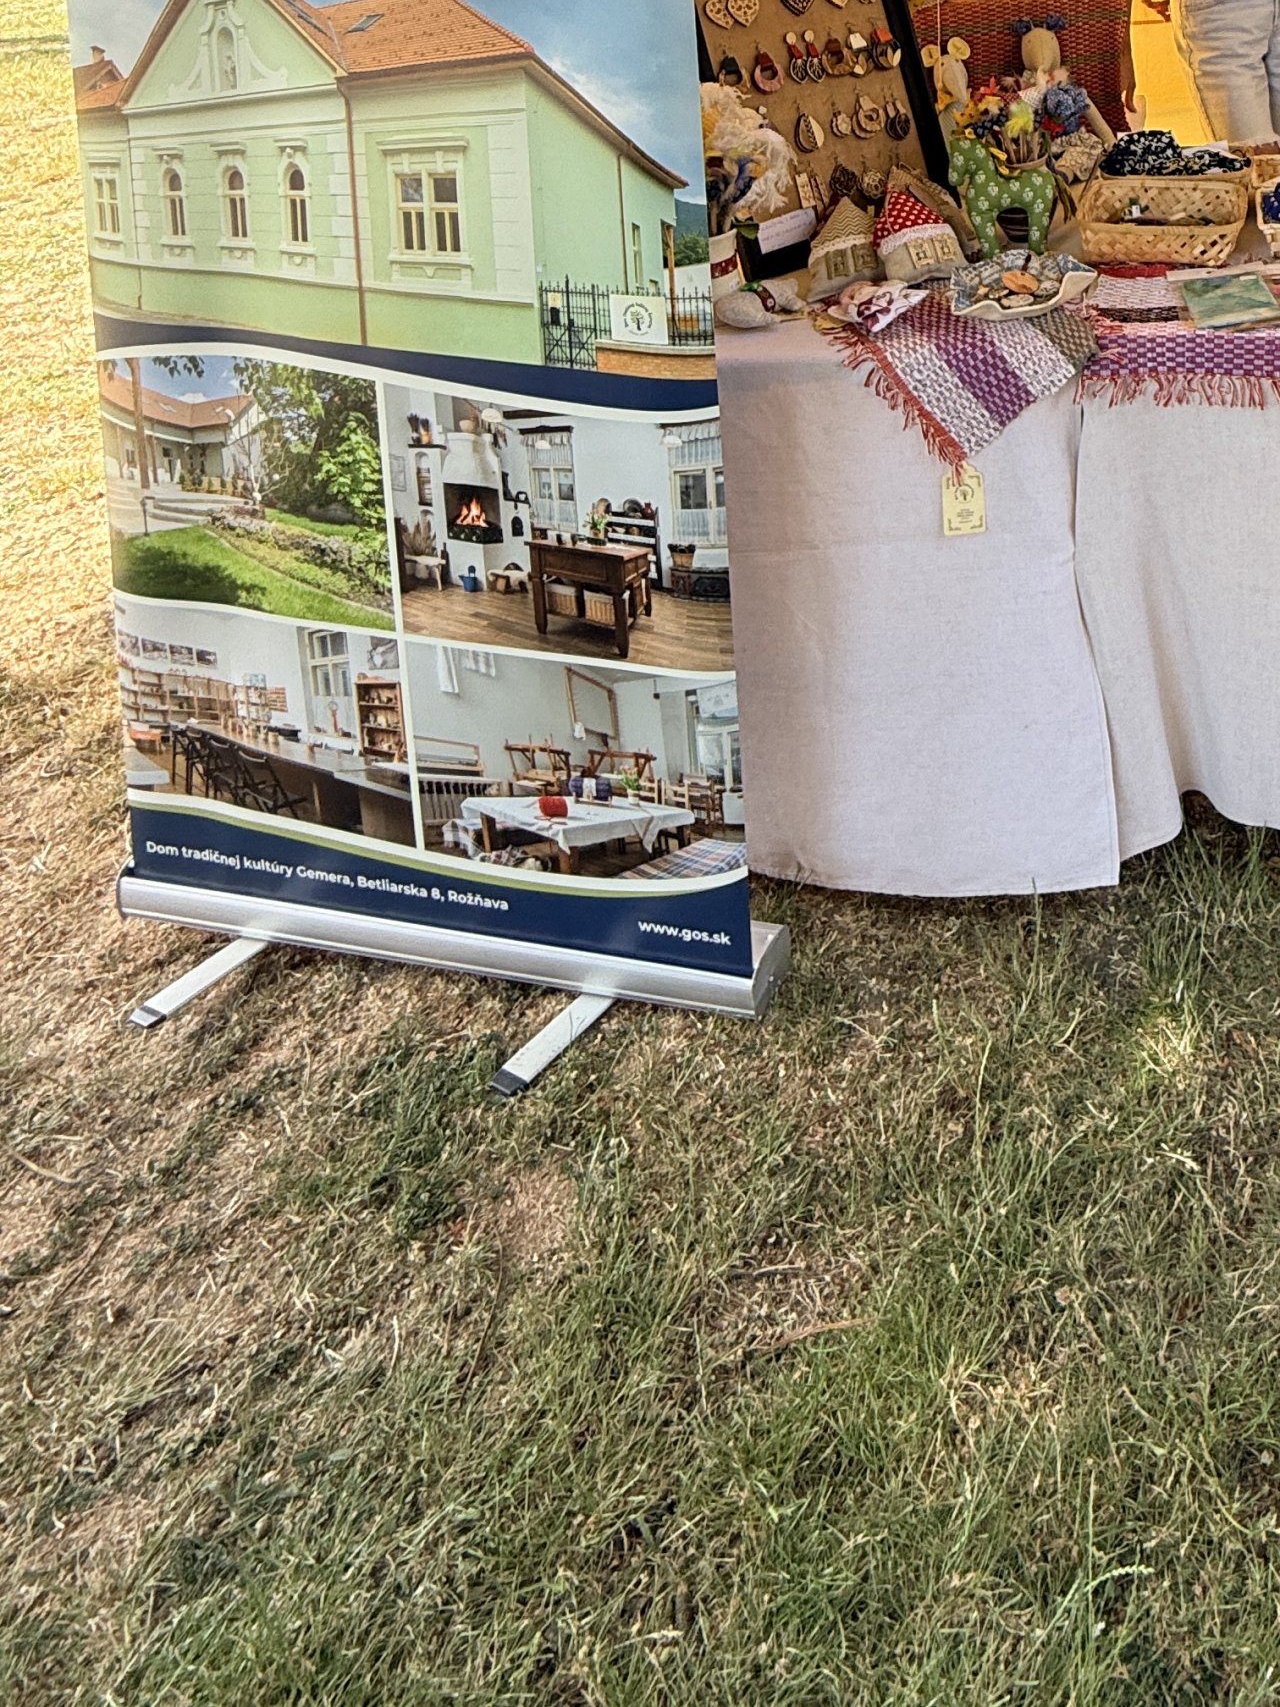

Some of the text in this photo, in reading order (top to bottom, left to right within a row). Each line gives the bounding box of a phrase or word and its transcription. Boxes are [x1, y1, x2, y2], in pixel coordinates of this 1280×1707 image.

[146, 840, 509, 911] Dom tradičnej kultúry Gemera, Betliarska 8, Rožňava
[637, 920, 732, 946] www.gos.sk
